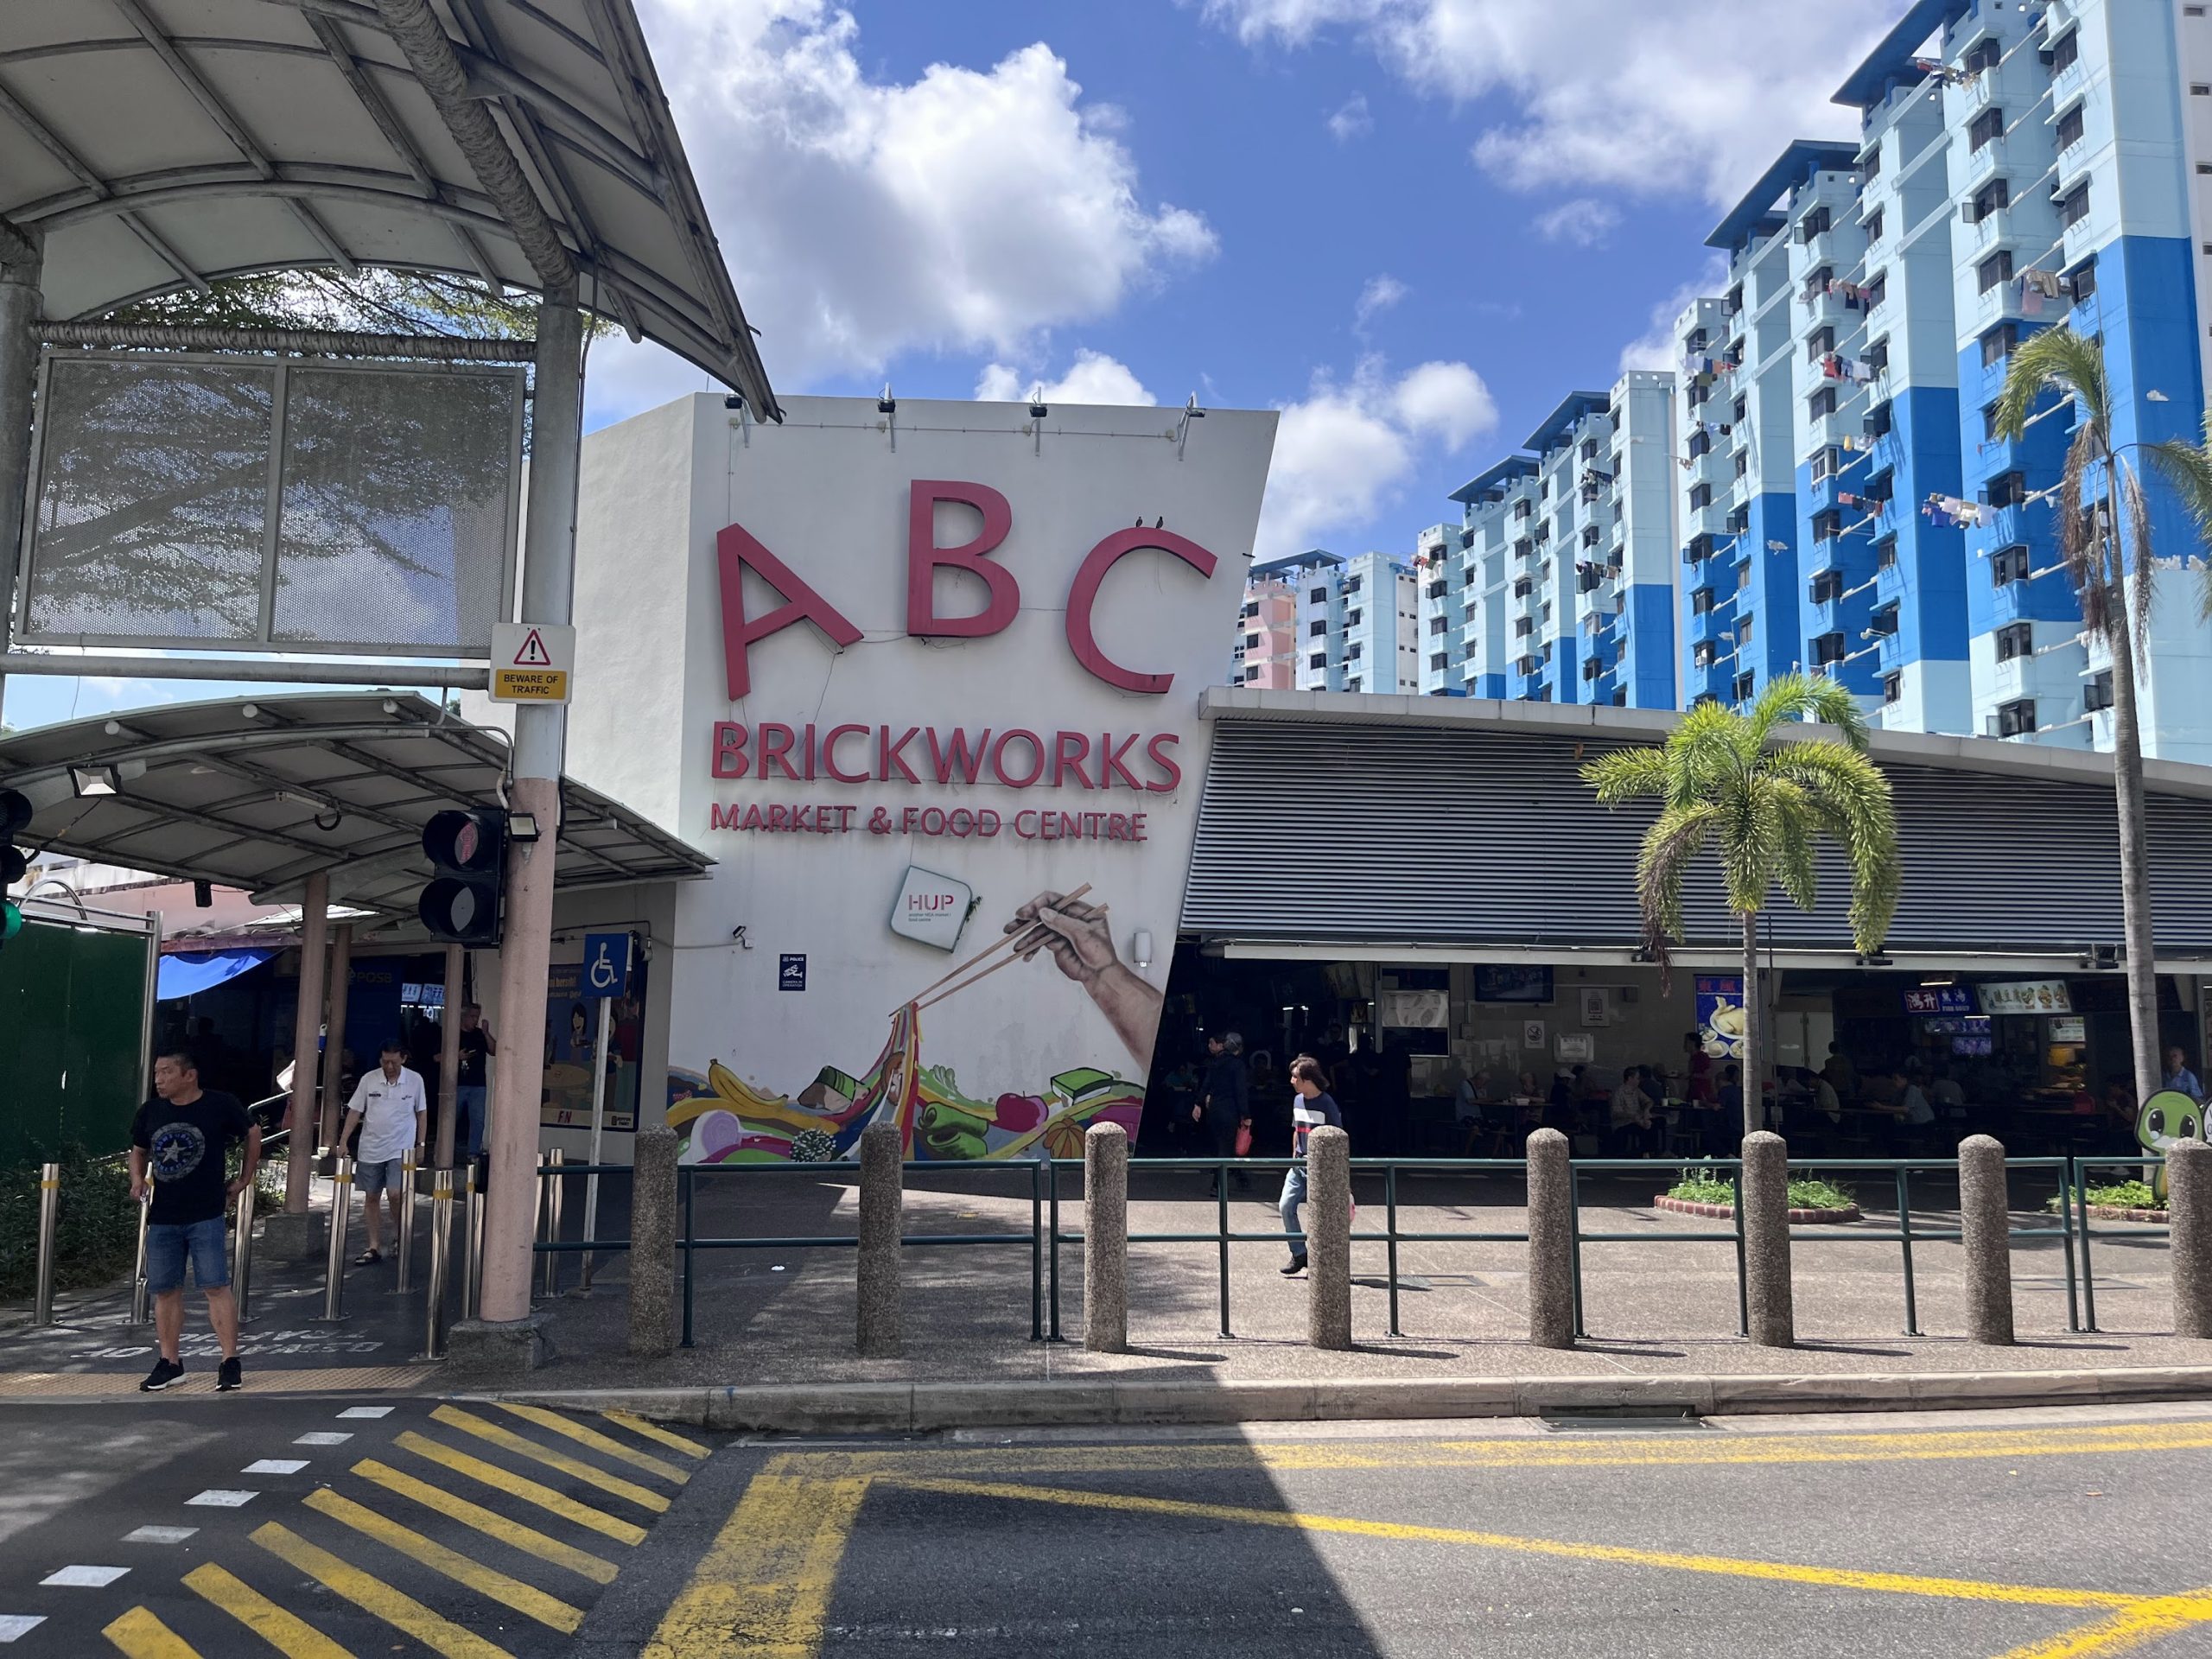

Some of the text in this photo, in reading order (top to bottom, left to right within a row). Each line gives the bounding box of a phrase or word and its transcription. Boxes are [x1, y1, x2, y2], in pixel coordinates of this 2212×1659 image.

[715, 479, 1219, 702] ABC
[504, 674, 559, 684] BEWARE OF
[512, 685, 550, 695] TRAFFIC
[710, 721, 1182, 793] BRICKWORKS
[710, 803, 1149, 842] MARKET & FOOD CENTRE
[908, 893, 954, 911] HUP
[356, 971, 393, 982] POSB
[70, 1346, 154, 1358] OF
